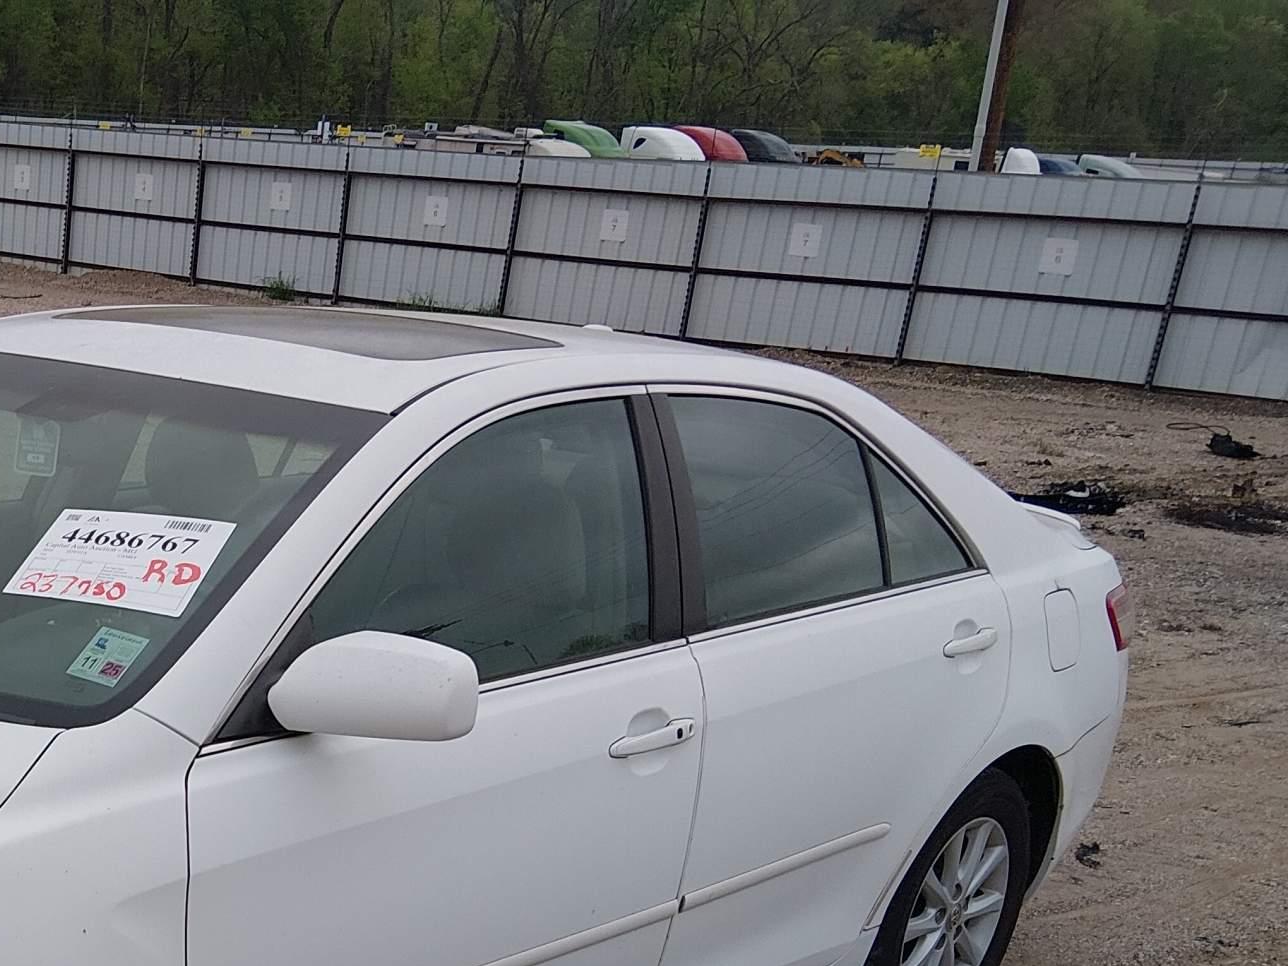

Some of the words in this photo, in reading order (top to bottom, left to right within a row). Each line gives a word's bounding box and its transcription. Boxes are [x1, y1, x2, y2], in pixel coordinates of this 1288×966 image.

[62, 528, 200, 554] 44686767
[142, 559, 202, 586] RD
[81, 655, 99, 671] 11
[100, 661, 123, 679] 25
